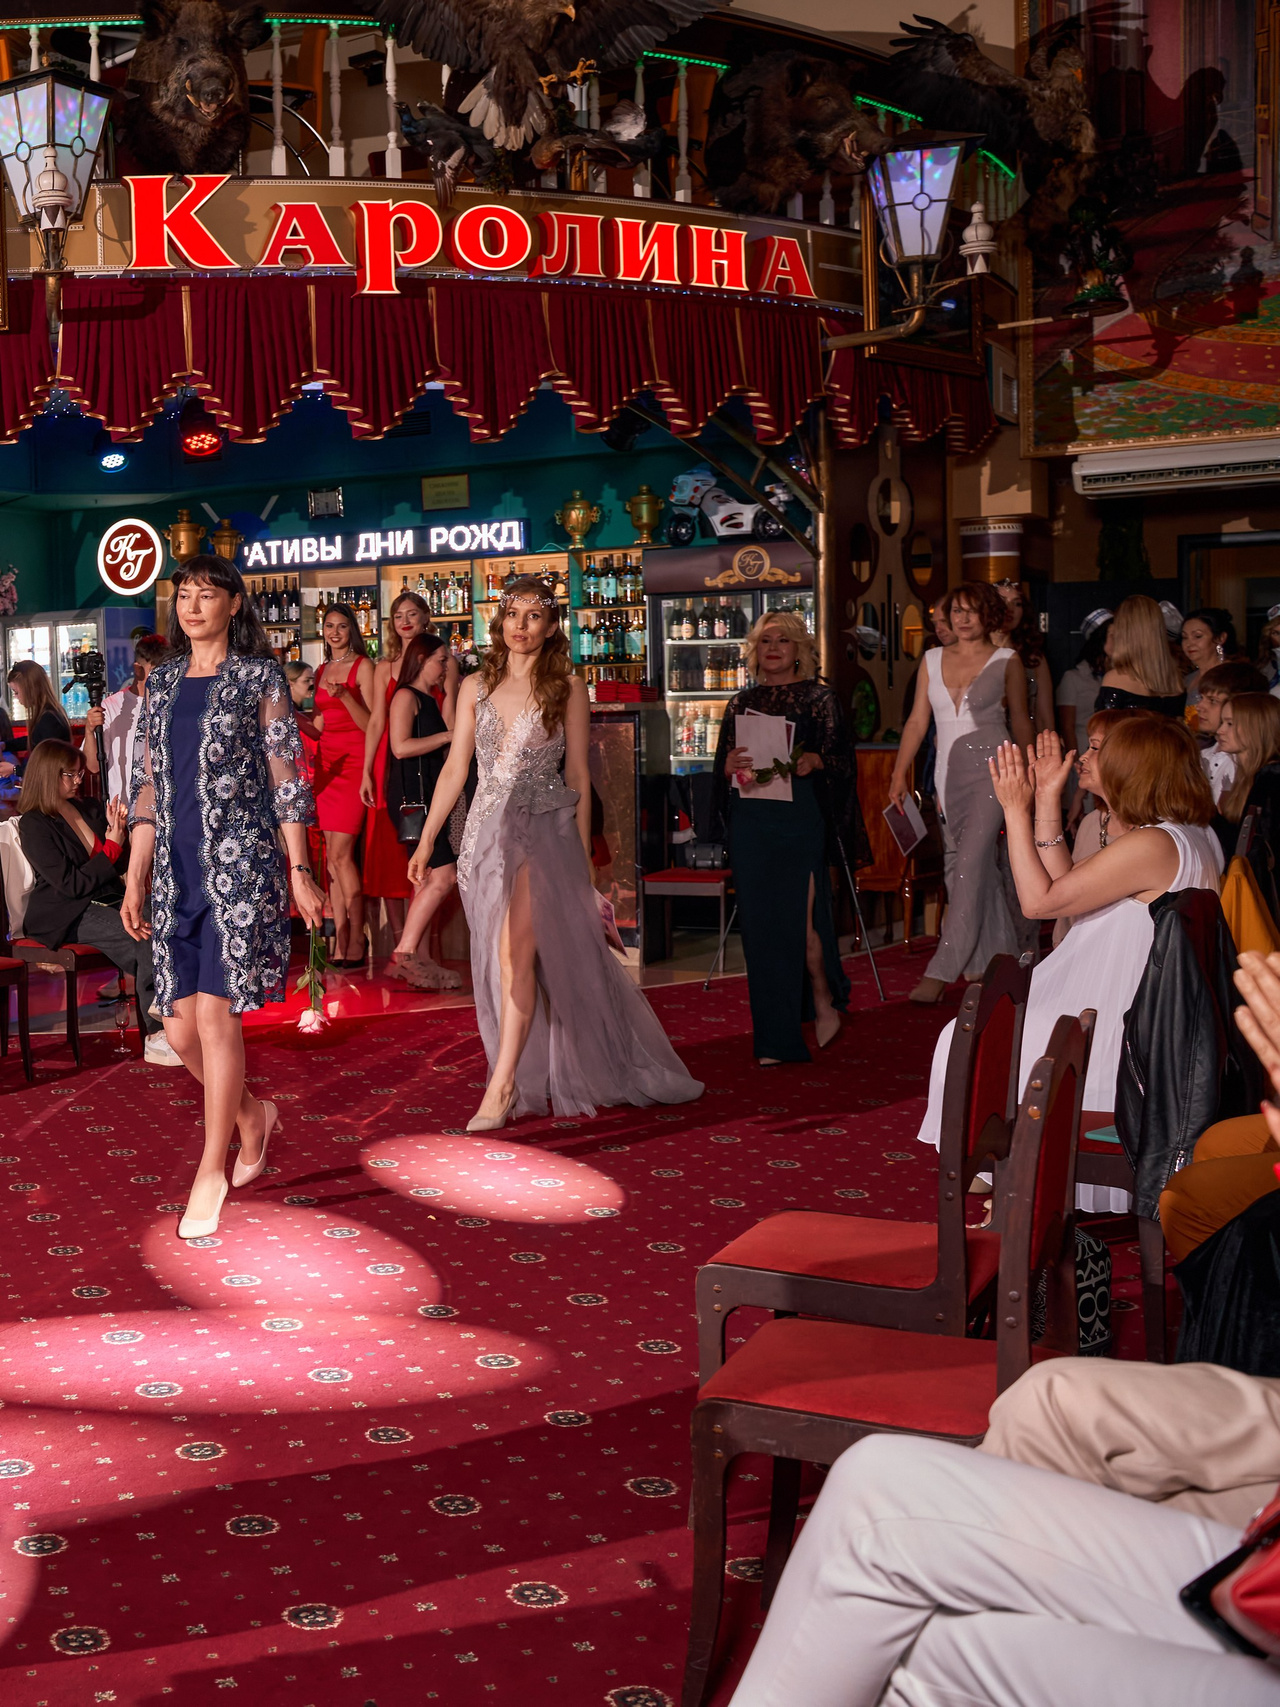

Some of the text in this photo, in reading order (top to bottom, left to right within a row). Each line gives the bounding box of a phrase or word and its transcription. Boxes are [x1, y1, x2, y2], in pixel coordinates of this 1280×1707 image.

[243, 520, 522, 567] АТИВЫ ДНИ РОЖД
